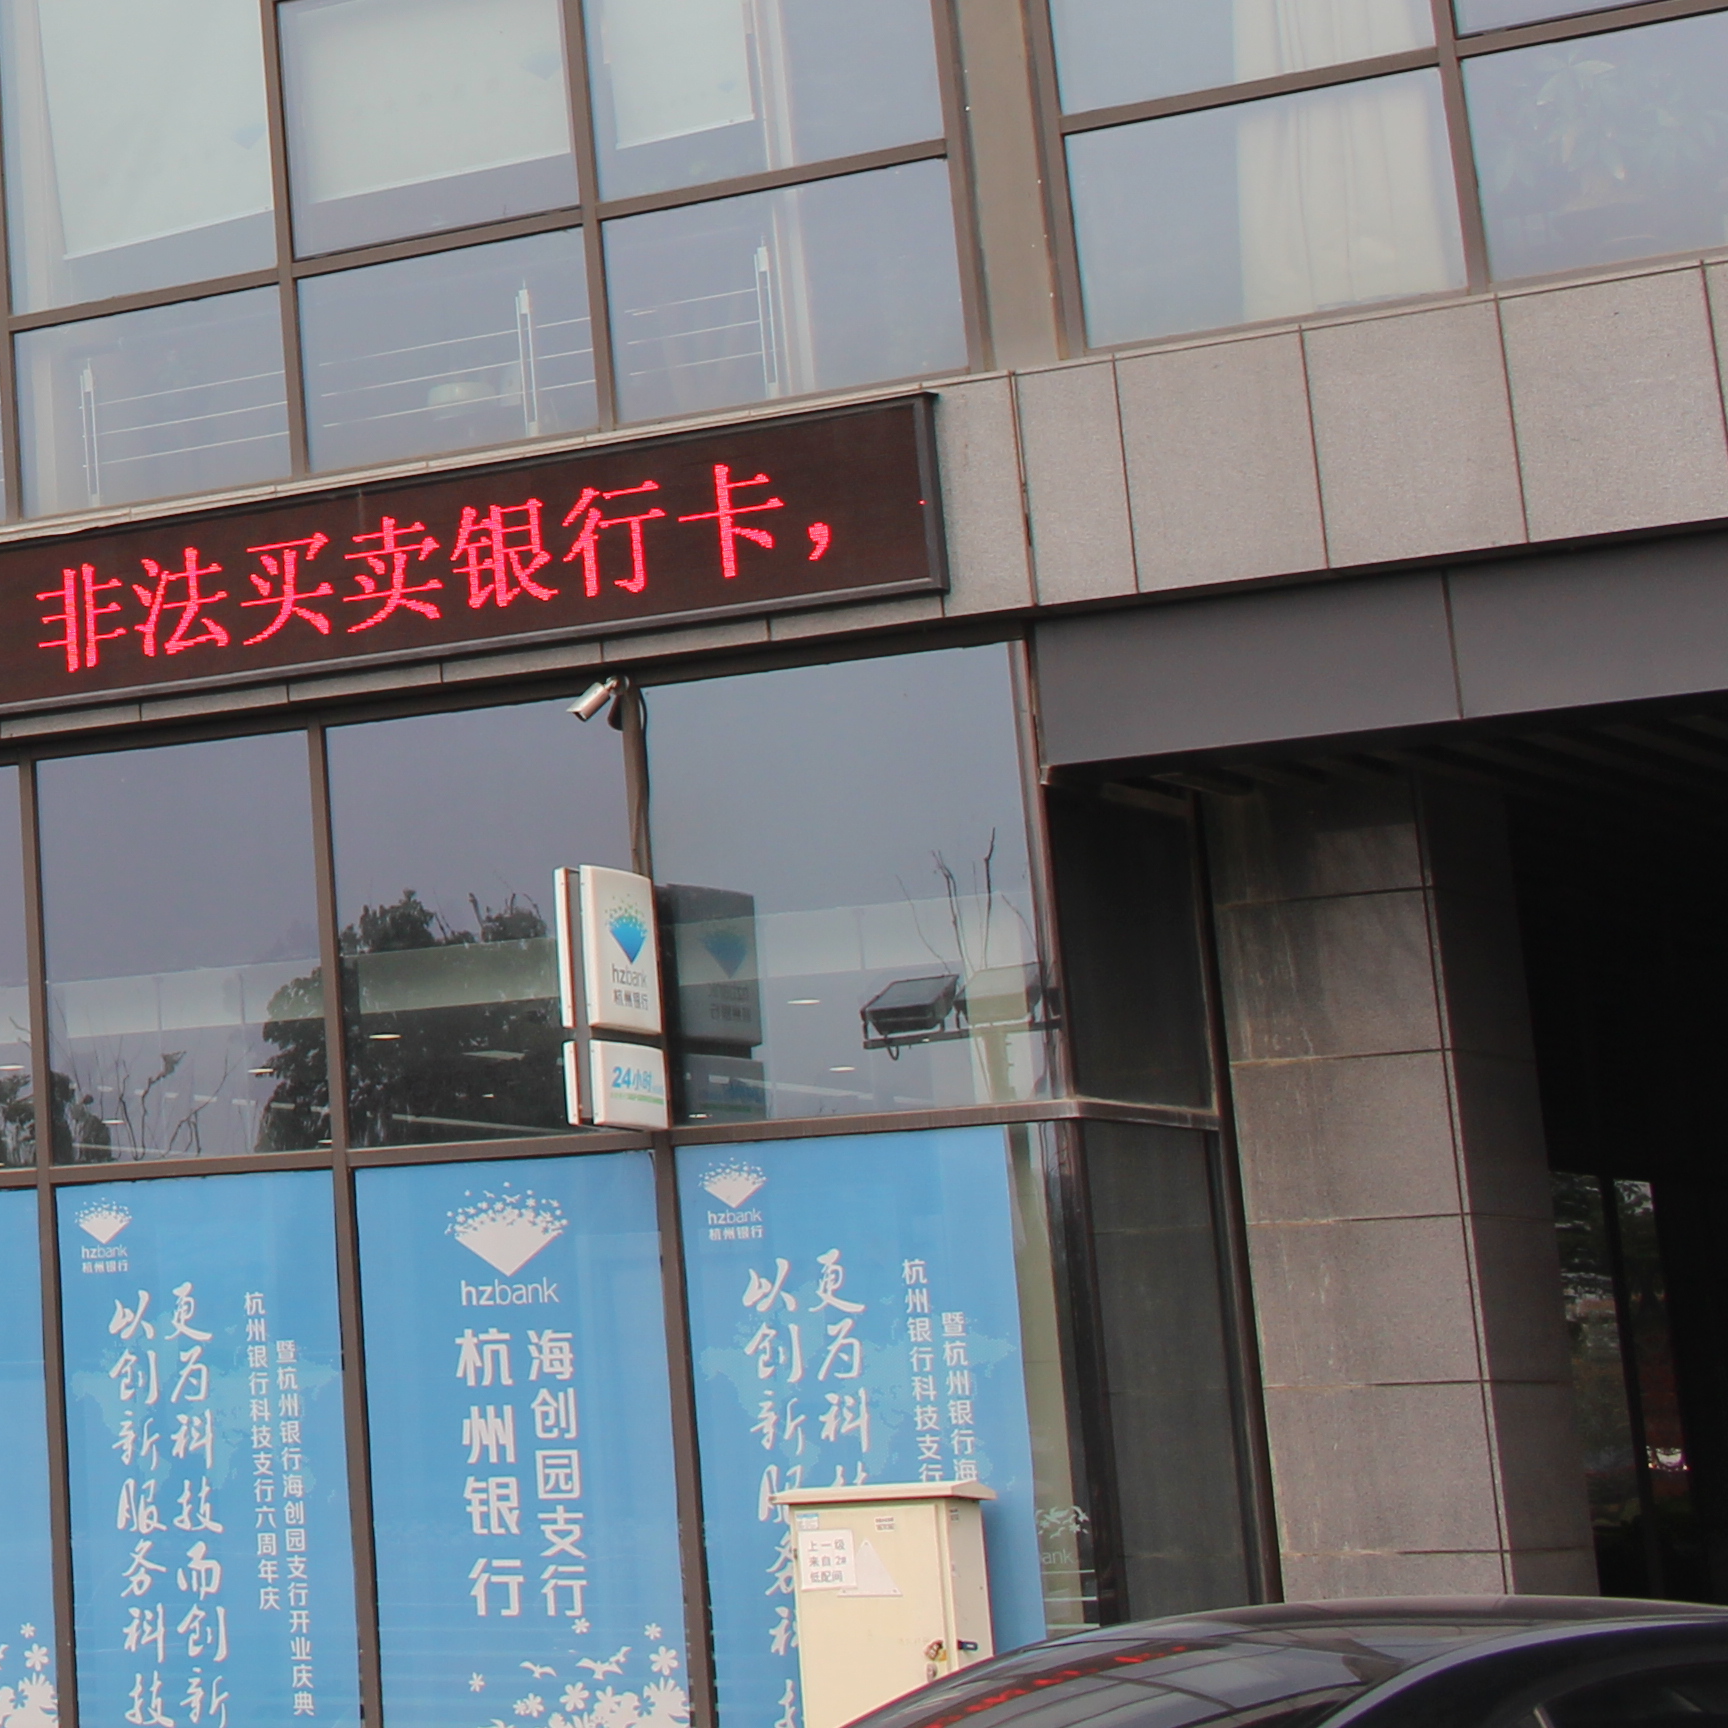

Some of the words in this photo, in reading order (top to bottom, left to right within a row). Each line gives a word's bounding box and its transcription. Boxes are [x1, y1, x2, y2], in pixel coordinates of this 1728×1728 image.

[36, 464, 830, 673] 非法买卖银行卡，
[611, 963, 648, 987] hzbank
[707, 1208, 763, 1225] hzbank
[708, 1225, 764, 1241] 杭州银行
[81, 1244, 128, 1259] hzbank
[82, 1259, 129, 1273] 杭州银行
[460, 1277, 560, 1306] hzbank
[244, 1291, 281, 1611] 杭州银行科技支行六周年庆
[455, 1328, 524, 1616] 杭州银行
[527, 1328, 588, 1617] 海创园支行
[276, 1340, 316, 1717] 暨杭州银行海创园支行开业庆典
